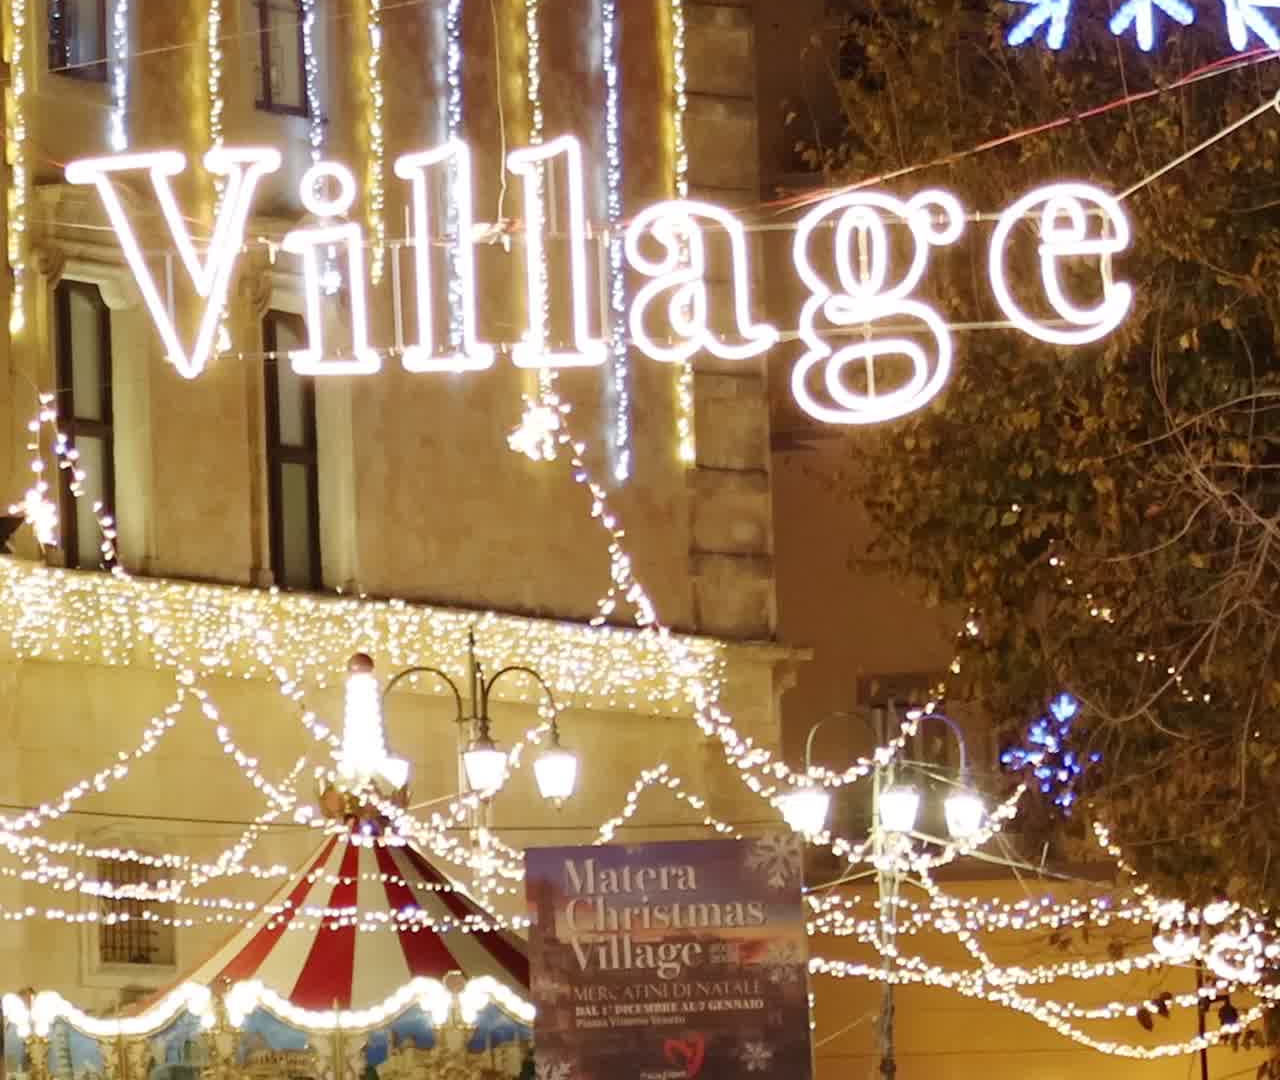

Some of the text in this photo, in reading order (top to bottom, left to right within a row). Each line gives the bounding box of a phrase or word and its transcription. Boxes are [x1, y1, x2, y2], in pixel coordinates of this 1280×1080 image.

[64, 133, 1134, 425] Village
[564, 858, 697, 895] Matera
[565, 895, 766, 933] Christmas
[570, 935, 703, 980] Village
